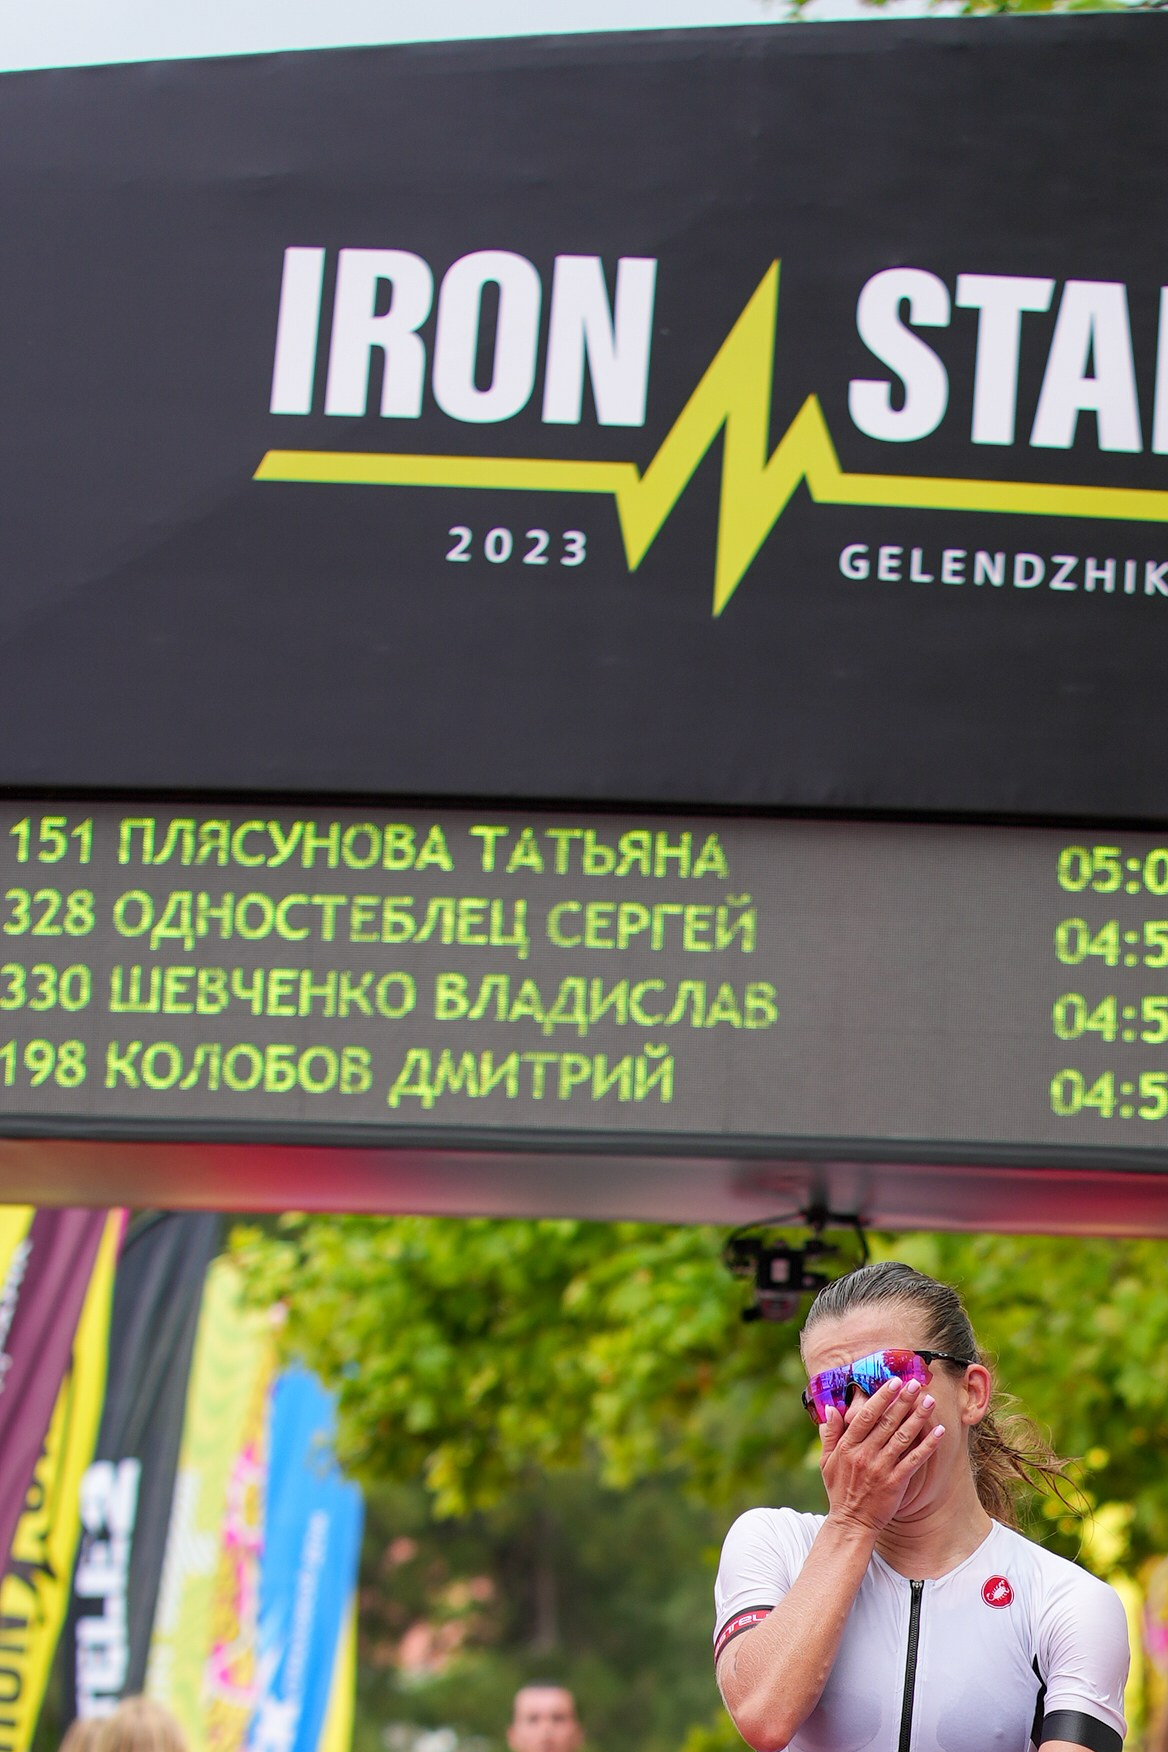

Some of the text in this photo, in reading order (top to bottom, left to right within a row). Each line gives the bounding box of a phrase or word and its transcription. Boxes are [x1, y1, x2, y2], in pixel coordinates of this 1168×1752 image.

[270, 247, 657, 426] IRON
[446, 526, 587, 567] 2023
[10, 816, 94, 864] 151
[117, 817, 454, 871] ПЛЯСУНОВА
[469, 824, 729, 879] ТАТЬЯНА
[2, 887, 96, 936] 328
[112, 888, 529, 960] ОДНОСТЕБЛЕЦ
[547, 893, 758, 953] СЕРГЕЙ
[0, 962, 92, 1012] 330
[108, 964, 417, 1018] ШЕВЧЕНКО
[434, 971, 779, 1036] ВЛАДИСЛАВ
[0, 1038, 87, 1088] 198
[104, 1040, 373, 1094] КОЛОБОВ
[387, 1043, 676, 1109] ДМИТРИЙ
